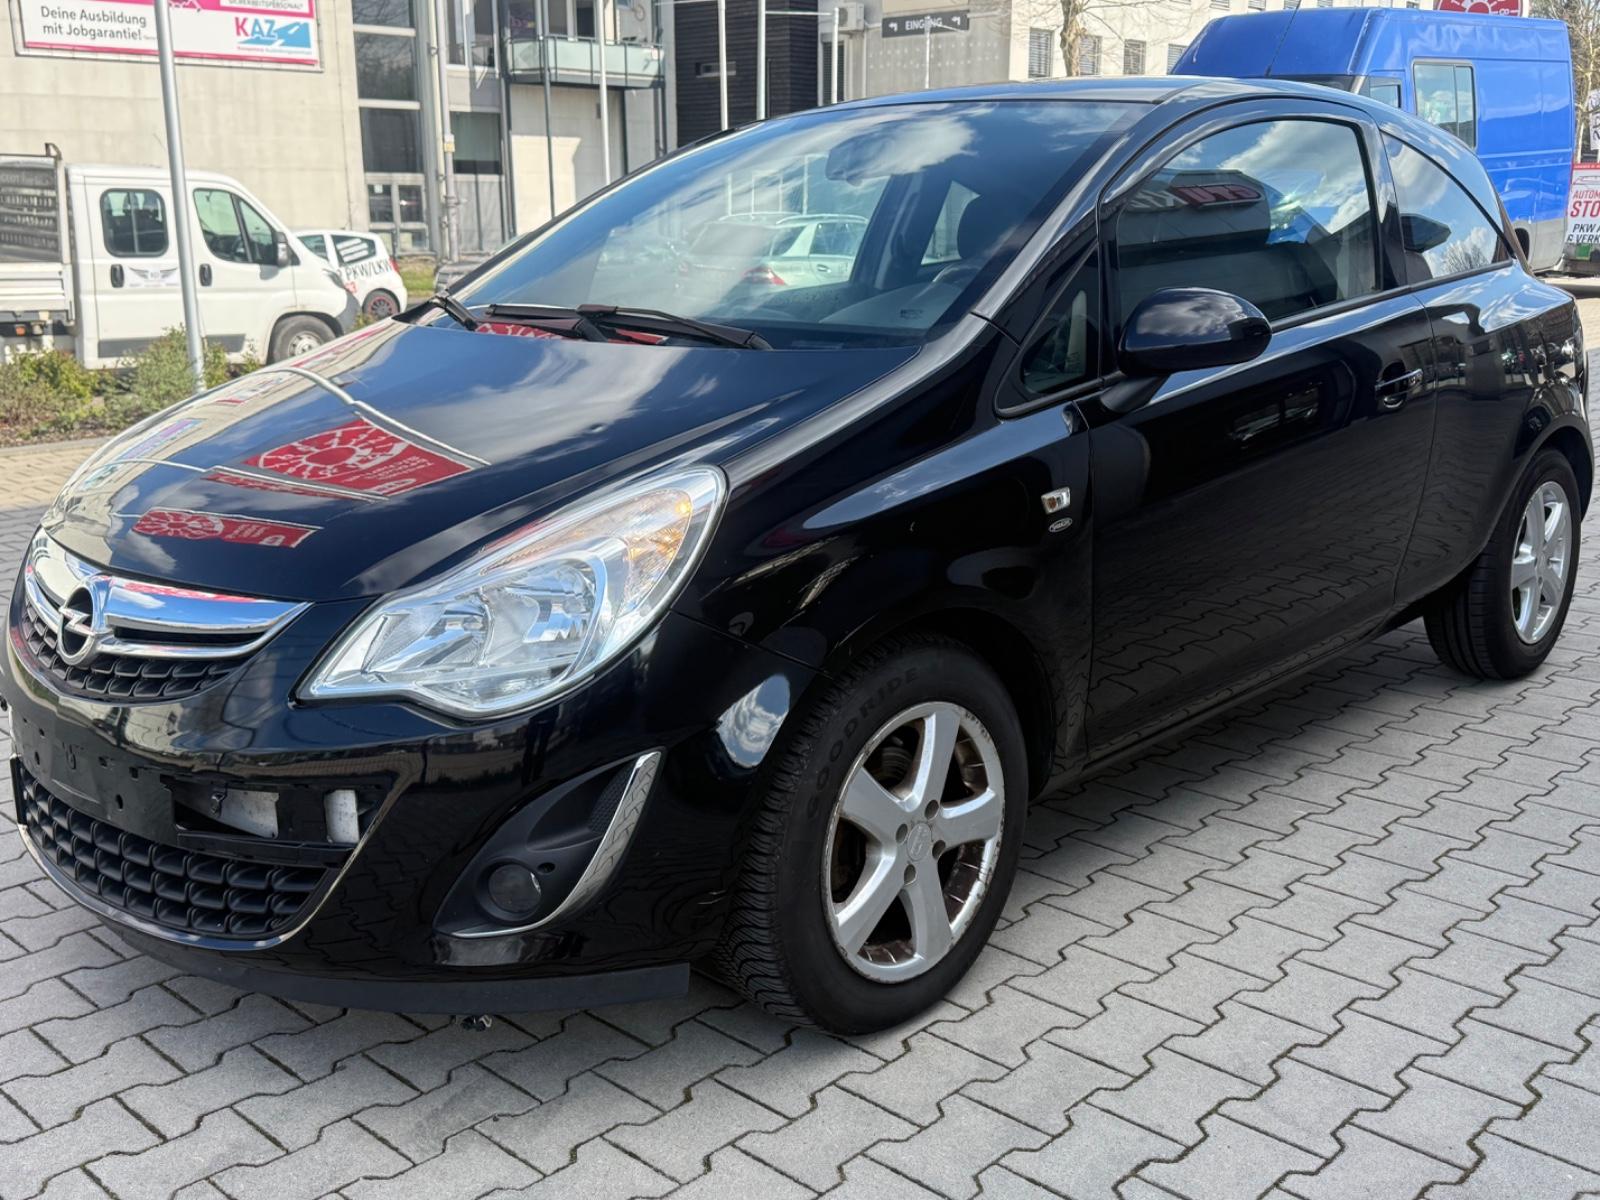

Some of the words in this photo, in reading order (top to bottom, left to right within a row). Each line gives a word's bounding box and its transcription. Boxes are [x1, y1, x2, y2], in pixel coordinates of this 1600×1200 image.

[41, 6, 76, 20] Deine
[80, 9, 146, 28] Ausbildung
[235, 16, 279, 38] KAZ
[43, 22, 63, 35] mit
[66, 23, 142, 41] Jobgarantie!
[1573, 223, 1596, 233] PKW
[806, 667, 919, 820] GOODRIDE
